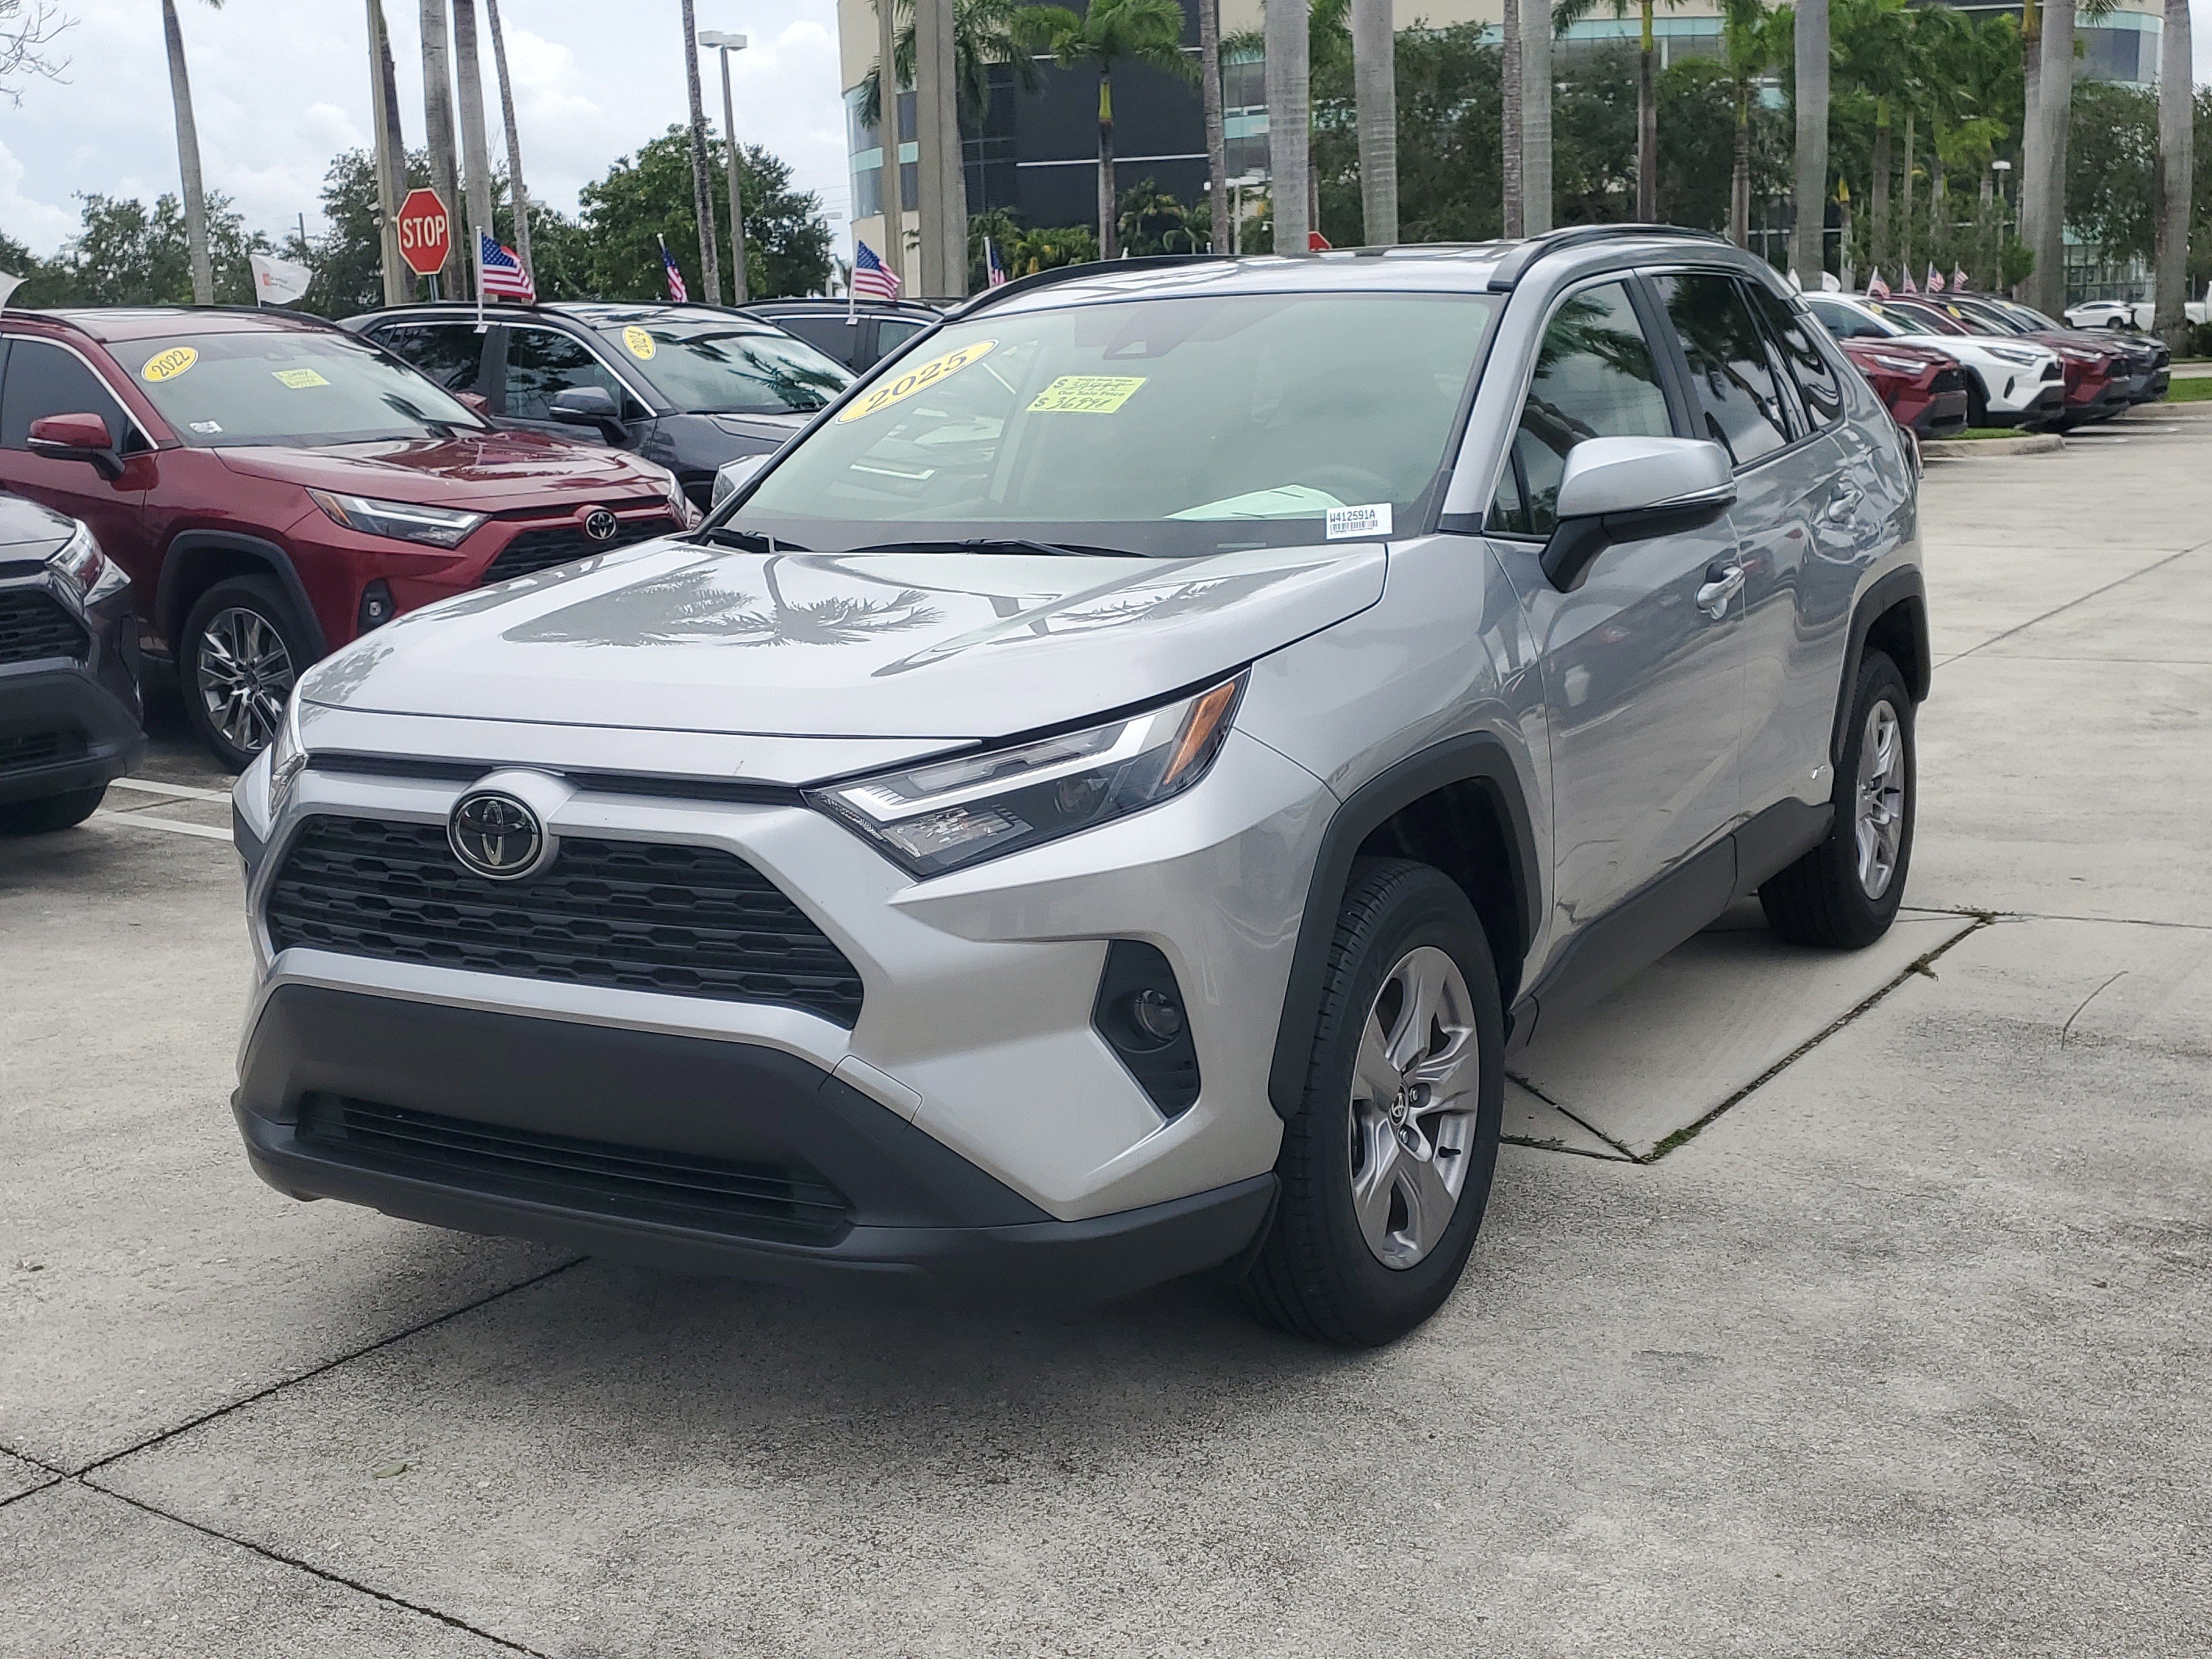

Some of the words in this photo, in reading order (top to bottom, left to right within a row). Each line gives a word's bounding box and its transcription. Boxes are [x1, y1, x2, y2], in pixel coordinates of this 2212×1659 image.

[402, 216, 446, 249] STOP
[151, 351, 191, 377] 2022
[865, 349, 969, 413] 2025
[1330, 509, 1375, 523] W412591A
